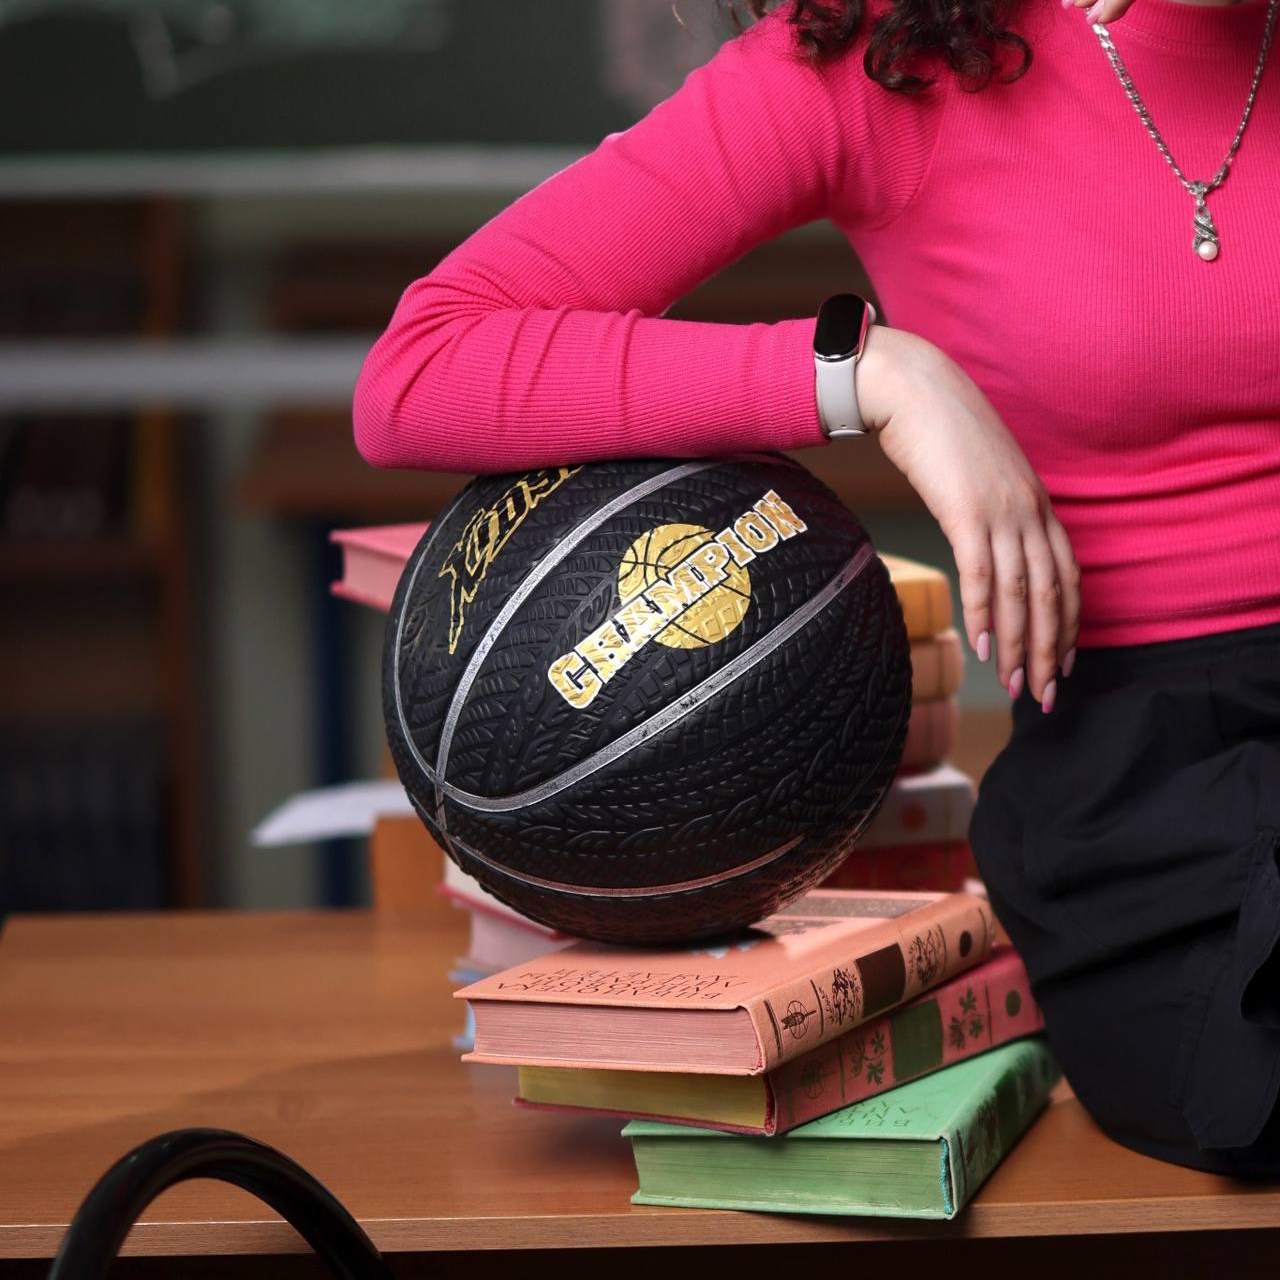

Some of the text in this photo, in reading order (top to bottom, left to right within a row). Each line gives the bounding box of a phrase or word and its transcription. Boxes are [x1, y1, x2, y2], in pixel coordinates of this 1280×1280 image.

[548, 489, 808, 709] CHAMPION
[518, 972, 747, 989] ЛИТЕРАТУРЫ
[497, 983, 723, 999] БИБЛИОТЕКА
